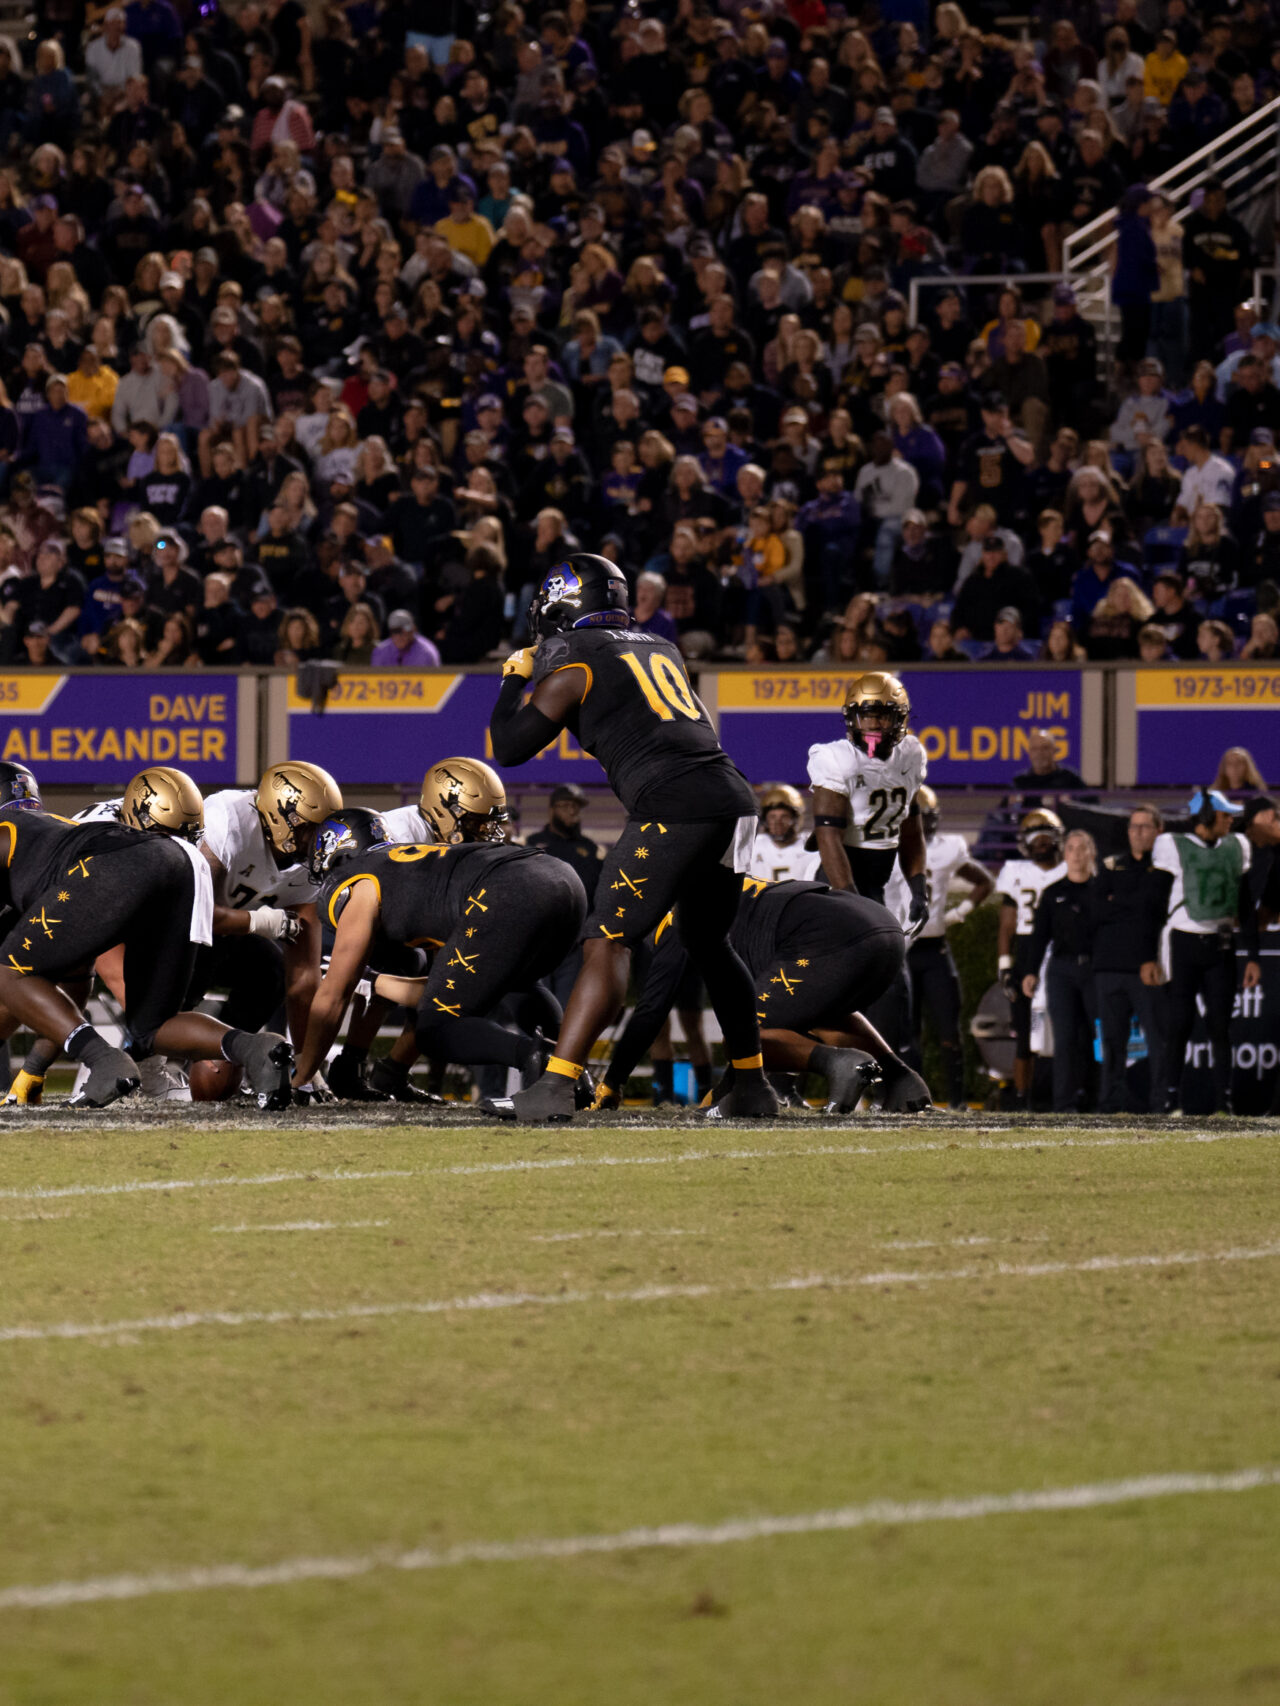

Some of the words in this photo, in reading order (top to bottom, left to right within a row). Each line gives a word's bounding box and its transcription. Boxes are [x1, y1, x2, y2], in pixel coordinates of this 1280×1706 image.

[331, 680, 424, 701] 972-1974
[619, 652, 702, 721] 10
[149, 695, 227, 722] DAVE
[1019, 692, 1069, 719] JIM
[1, 728, 227, 761] ALEXANDER
[909, 726, 1069, 761] OLDING
[863, 786, 907, 841] 22
